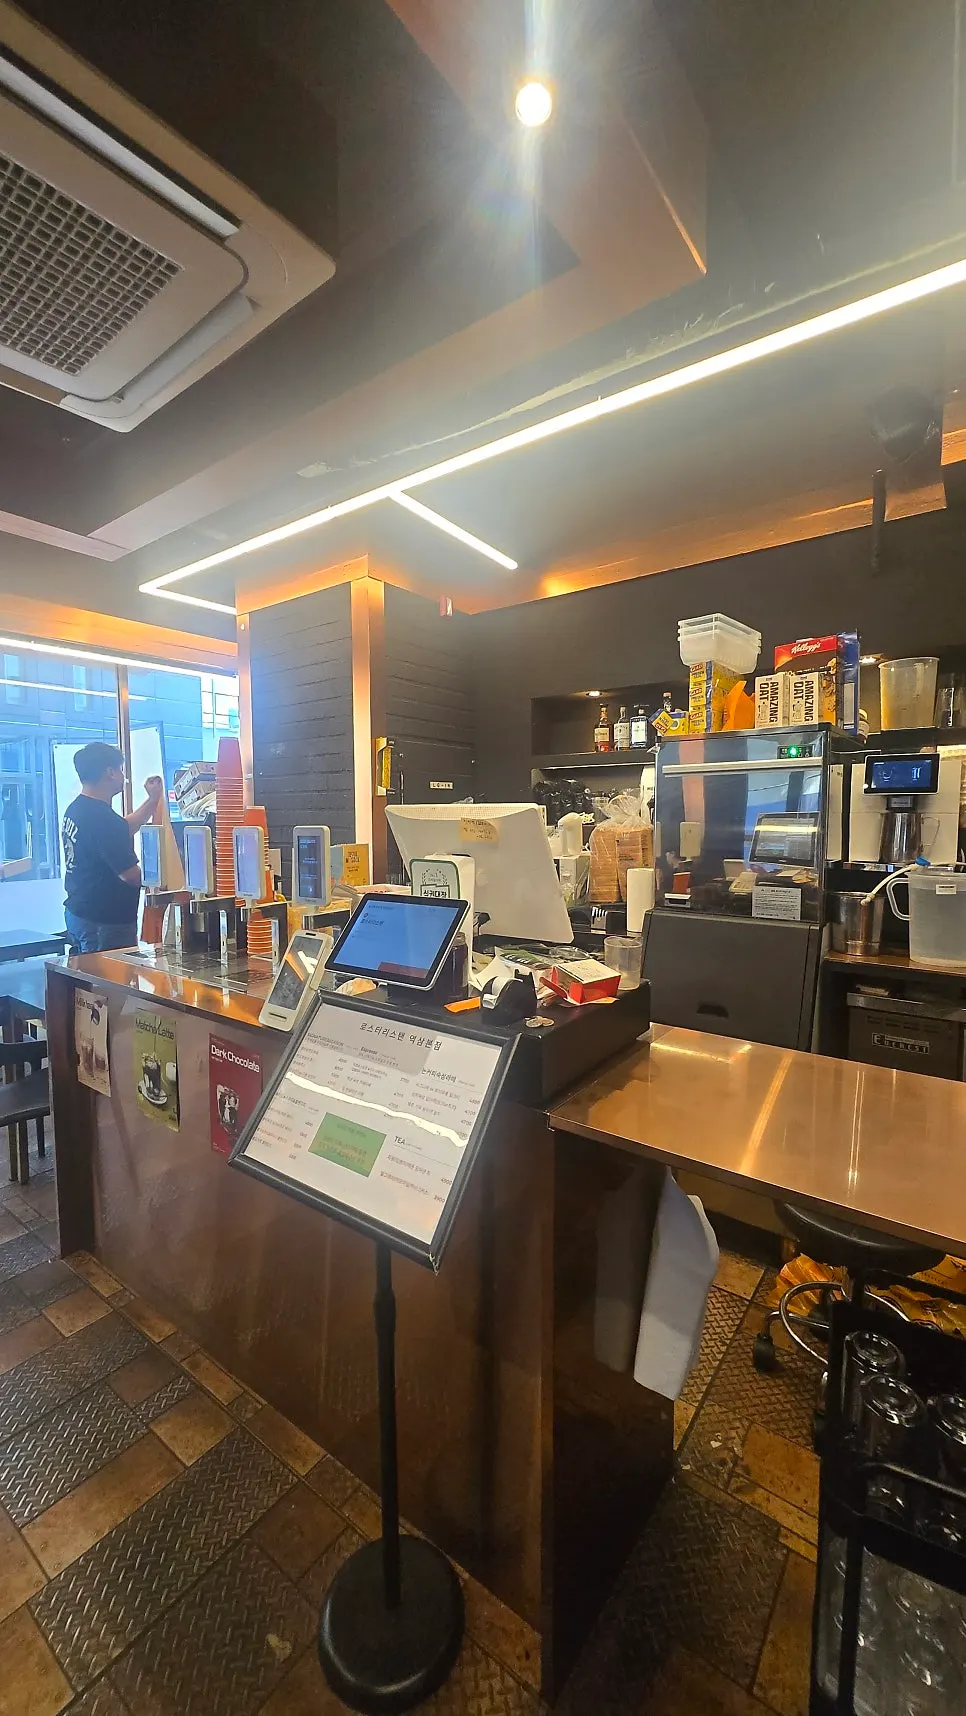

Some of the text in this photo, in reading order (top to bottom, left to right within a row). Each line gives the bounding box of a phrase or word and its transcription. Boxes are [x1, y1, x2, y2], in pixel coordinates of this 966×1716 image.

[791, 642, 822, 654] Kellogg's
[760, 682, 769, 701] OAT
[793, 681, 803, 700] OAT
[769, 681, 779, 723] AMAZING
[804, 680, 814, 722] AMAZING
[409, 1034, 442, 1051] 역삼본점
[211, 1044, 260, 1073] Dark Chocolate
[394, 1135, 406, 1145] TEA
